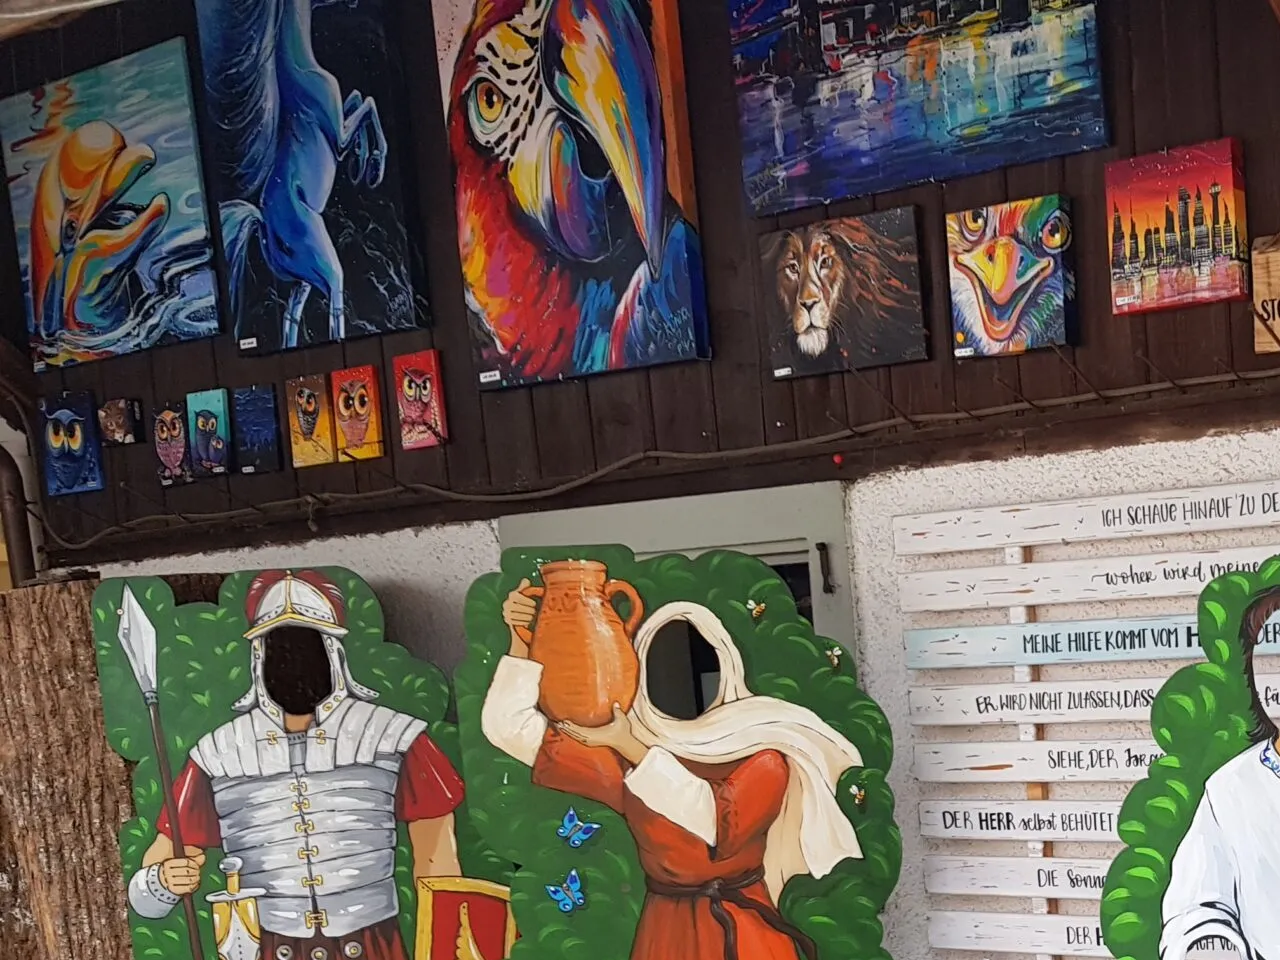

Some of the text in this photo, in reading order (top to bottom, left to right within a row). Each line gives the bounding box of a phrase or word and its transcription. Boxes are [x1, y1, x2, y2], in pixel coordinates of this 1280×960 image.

[1101, 508, 1122, 527] ICH
[1182, 496, 1233, 521] HINAUF
[1023, 633, 1063, 654] MEINE
[1067, 630, 1102, 652] HILFE
[1105, 628, 1148, 652] KOMMT
[1151, 627, 1179, 648] VOM
[975, 695, 998, 714] ER
[999, 693, 1027, 711] WIRD
[1029, 691, 1064, 711] NICHT
[942, 810, 973, 831] DER
[978, 811, 1016, 831] HERR
[1018, 811, 1057, 832] selbst
[1061, 810, 1114, 832] BEHÜTET
[1037, 868, 1059, 888] DIE
[1066, 926, 1093, 945] DER
